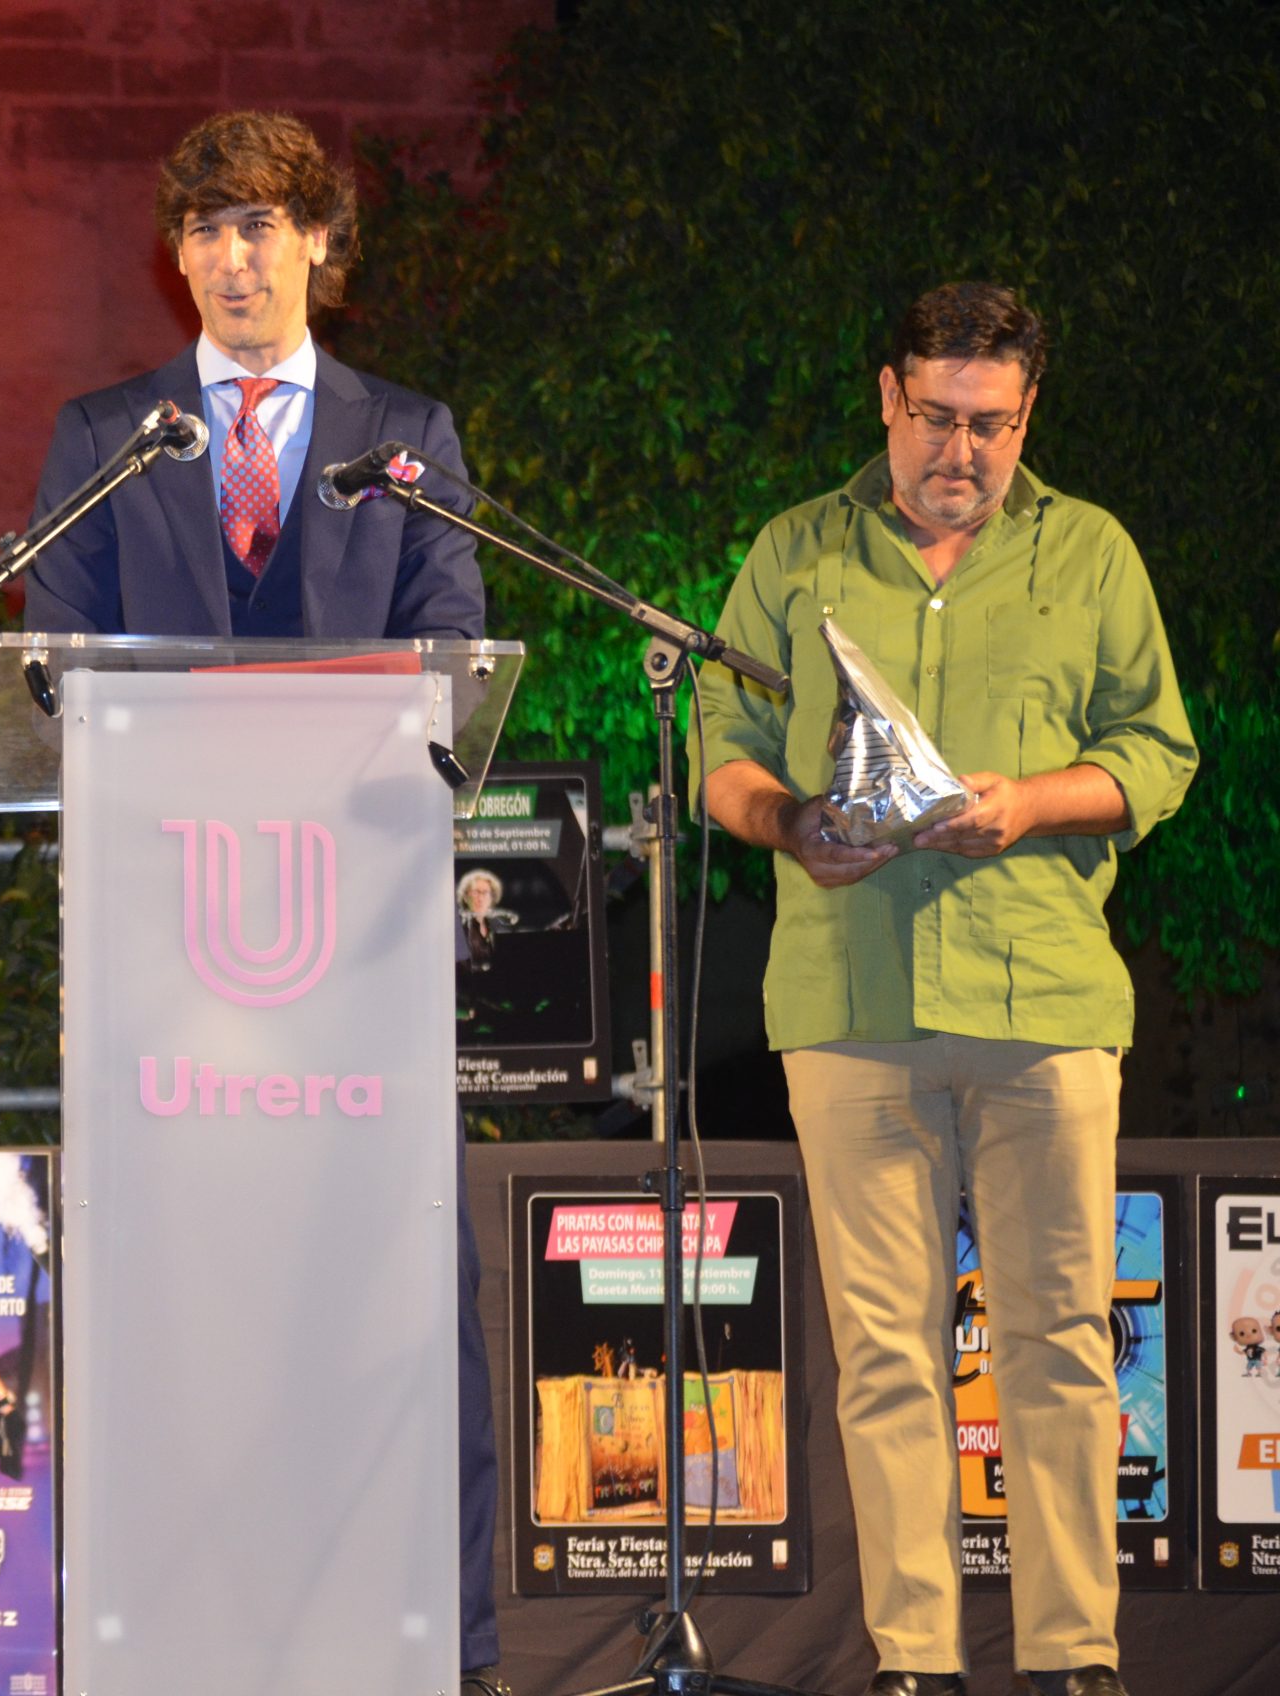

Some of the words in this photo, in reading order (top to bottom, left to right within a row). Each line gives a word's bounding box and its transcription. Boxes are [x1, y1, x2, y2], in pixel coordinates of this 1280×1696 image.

[479, 792, 531, 817] OBREGÓN
[480, 827, 493, 839] de
[494, 827, 551, 840] Septiembre
[457, 1058, 500, 1072] Fiestas
[456, 1073, 471, 1084] ra.
[473, 1072, 489, 1084] de
[491, 1069, 569, 1084] Consolación
[139, 1056, 383, 1118] Utrera
[556, 1213, 606, 1232] PIRATAS
[608, 1213, 634, 1231] CON
[636, 1213, 664, 1231] MAL
[707, 1213, 717, 1231] Y
[557, 1235, 580, 1254] LAS
[582, 1235, 635, 1253] PAYASAS
[636, 1235, 664, 1253] CHIP
[681, 1234, 722, 1252] CHPA
[588, 1268, 646, 1282] Domingo,
[588, 1284, 629, 1296] Caseta
[699, 1284, 726, 1295] 9:00
[957, 1425, 1000, 1454] ORQU
[567, 1536, 606, 1552] Feria
[608, 1541, 618, 1555] y
[620, 1536, 667, 1552] Fiestas
[961, 1534, 990, 1549] eria
[992, 1537, 1003, 1552] y
[1251, 1534, 1280, 1549] Feri
[567, 1552, 606, 1568] Ntra.
[608, 1551, 638, 1568] Sra.
[639, 1552, 658, 1568] de
[961, 1551, 990, 1565] tra.
